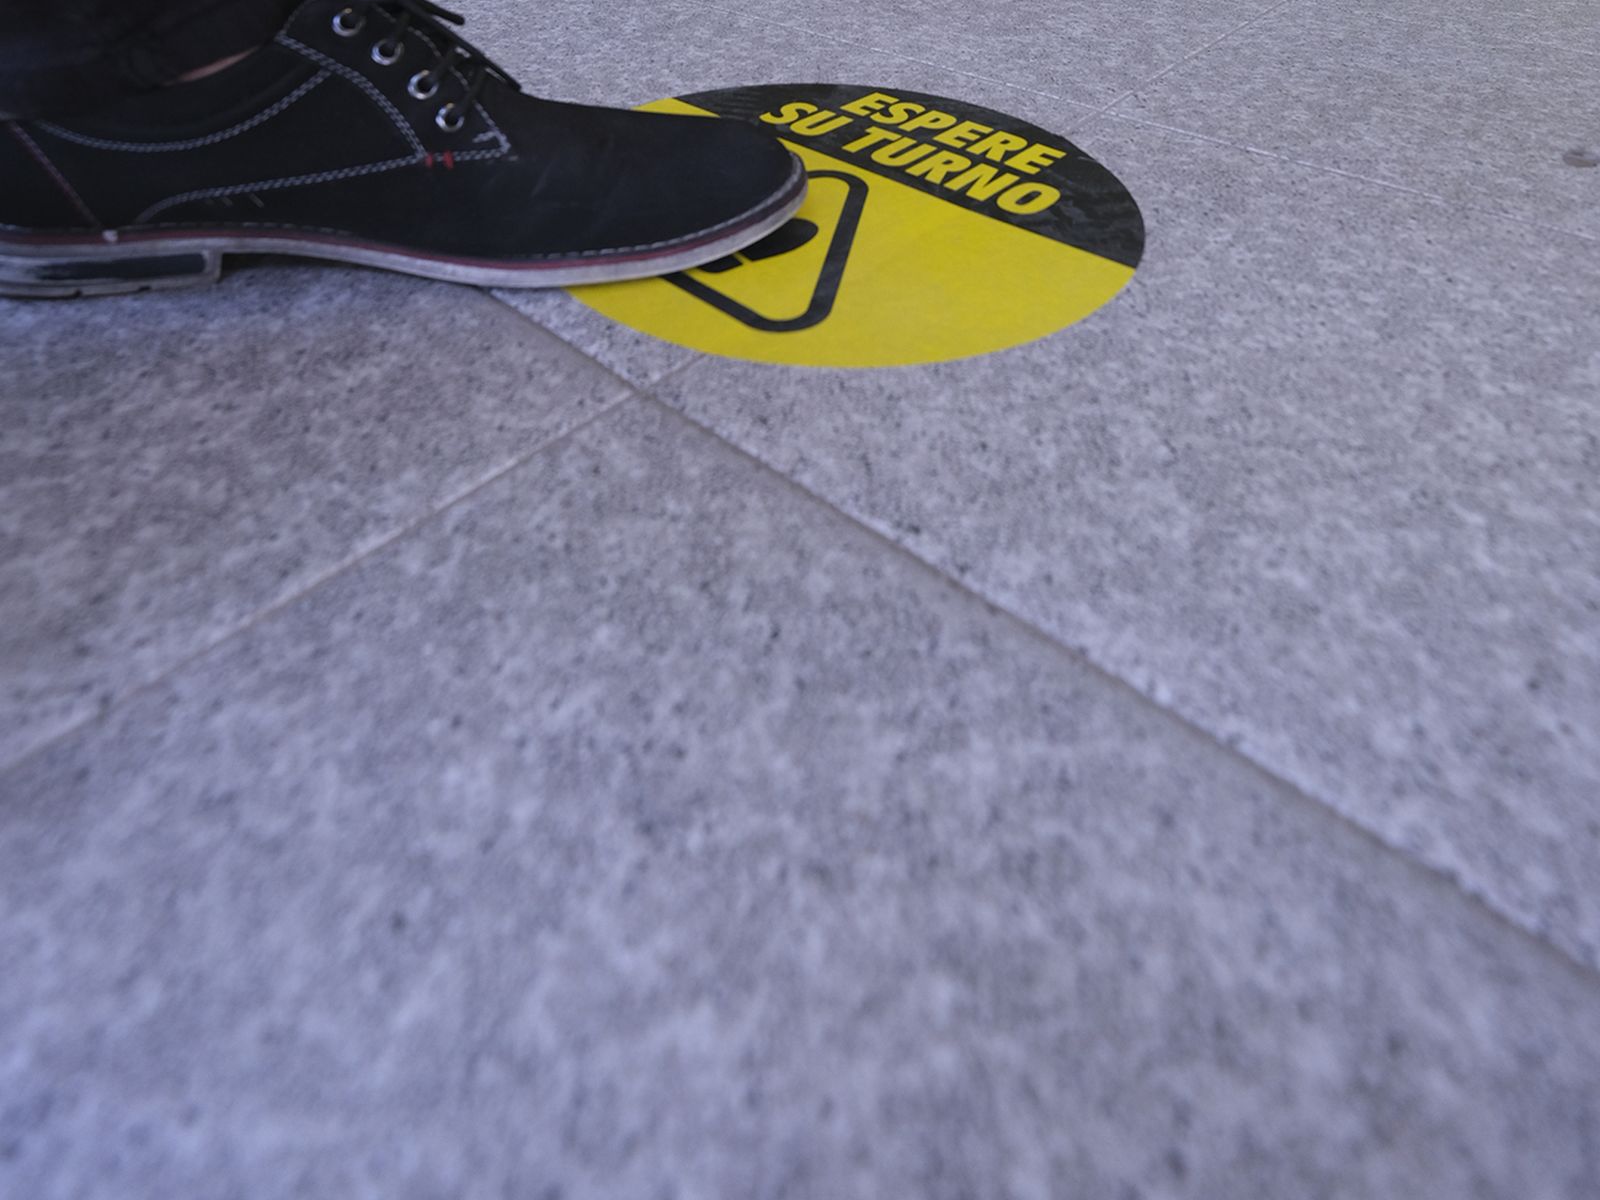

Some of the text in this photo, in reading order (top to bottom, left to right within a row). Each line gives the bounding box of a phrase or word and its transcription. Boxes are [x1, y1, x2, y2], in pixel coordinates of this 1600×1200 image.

[759, 102, 1062, 215] SU TURNO
[840, 92, 1067, 175] ESPERE
